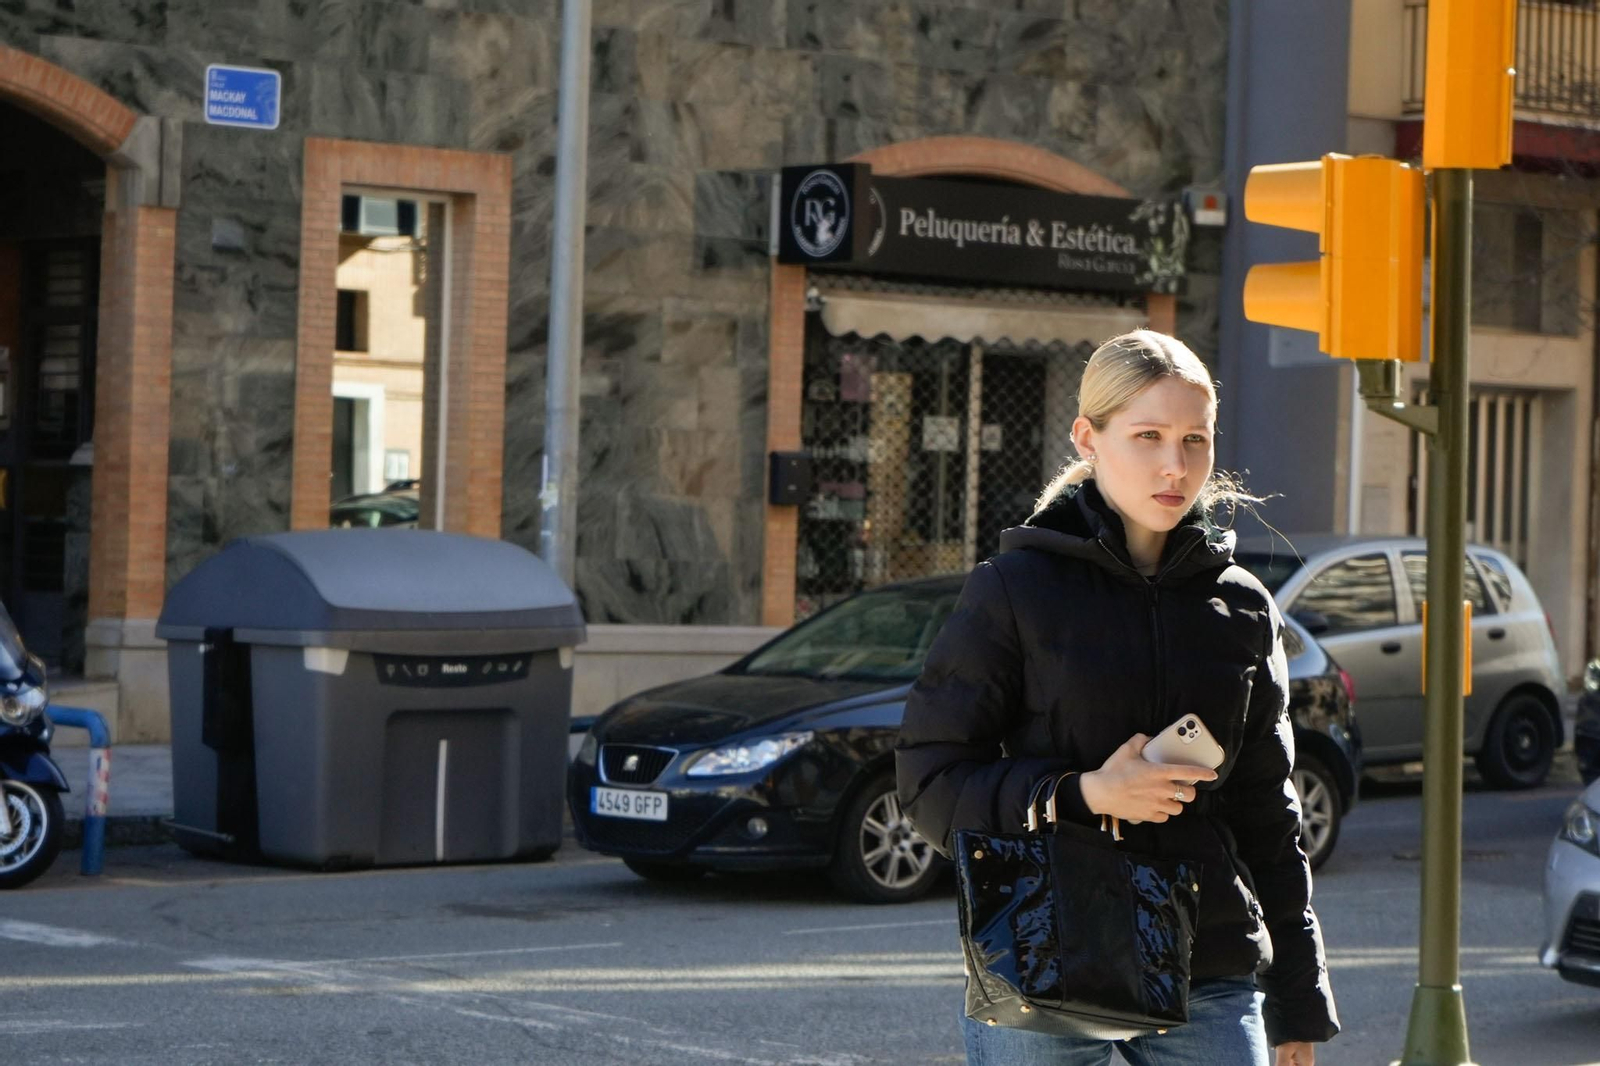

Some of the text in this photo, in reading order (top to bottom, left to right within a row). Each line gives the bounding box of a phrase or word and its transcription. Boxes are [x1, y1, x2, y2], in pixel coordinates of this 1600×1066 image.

[209, 89, 246, 103] MACKAY
[900, 207, 1021, 248] Peluquería
[1026, 218, 1045, 247] &
[441, 663, 468, 674] Resto
[599, 792, 663, 815] 4549 GFP
